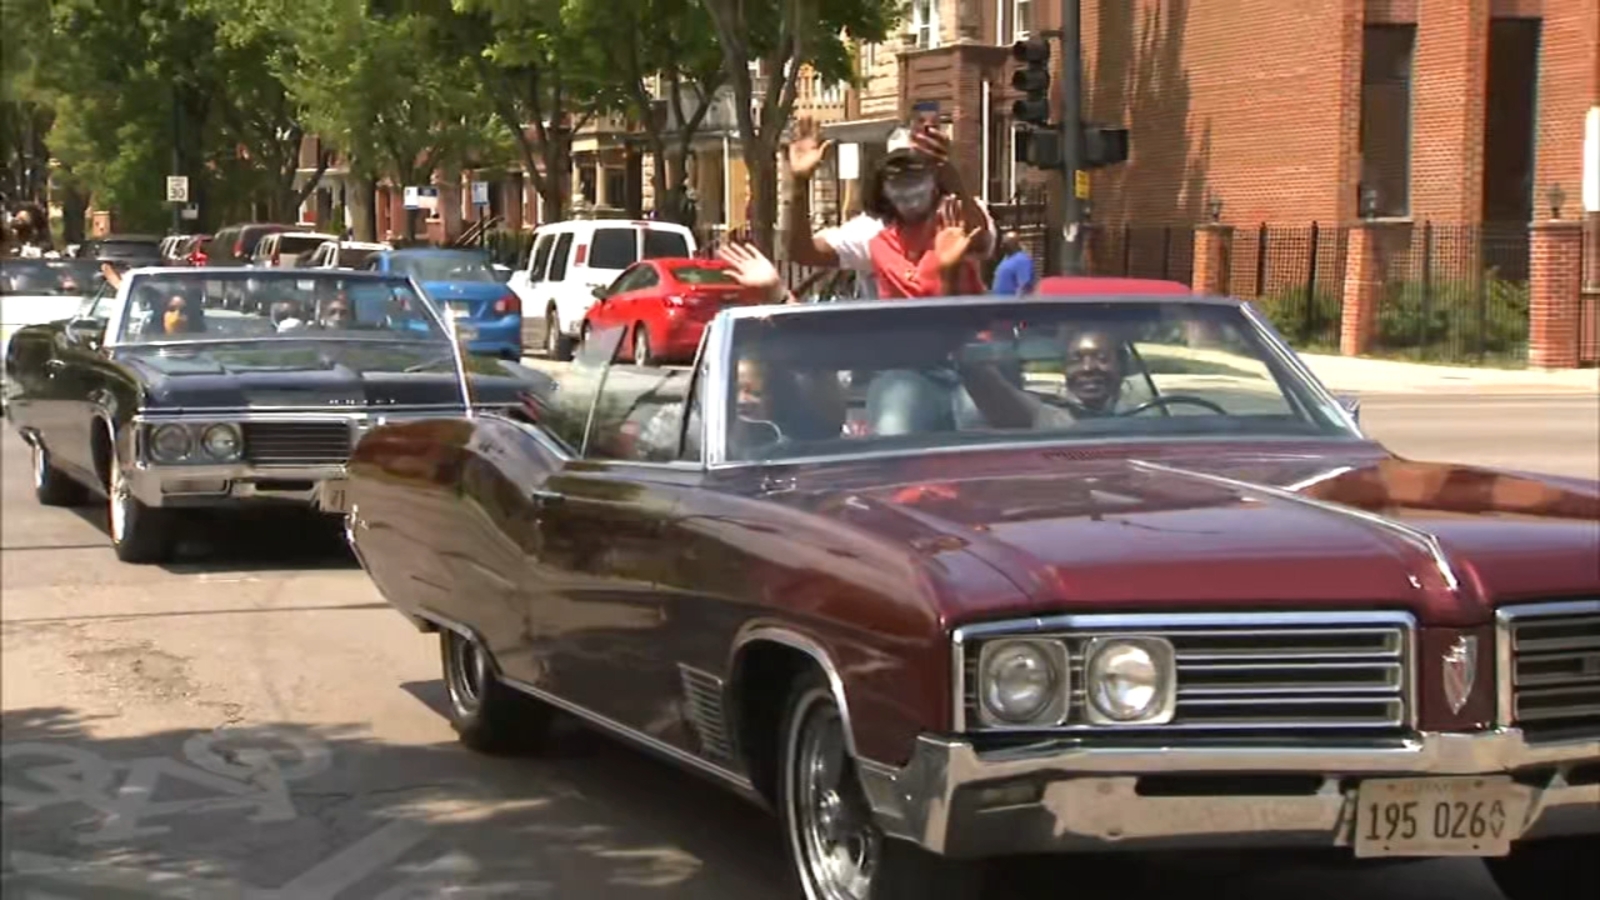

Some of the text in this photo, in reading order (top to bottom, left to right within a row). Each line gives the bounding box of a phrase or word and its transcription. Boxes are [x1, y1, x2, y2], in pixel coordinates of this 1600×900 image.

[170, 187, 185, 199] 30
[1366, 801, 1486, 840] 195 026
